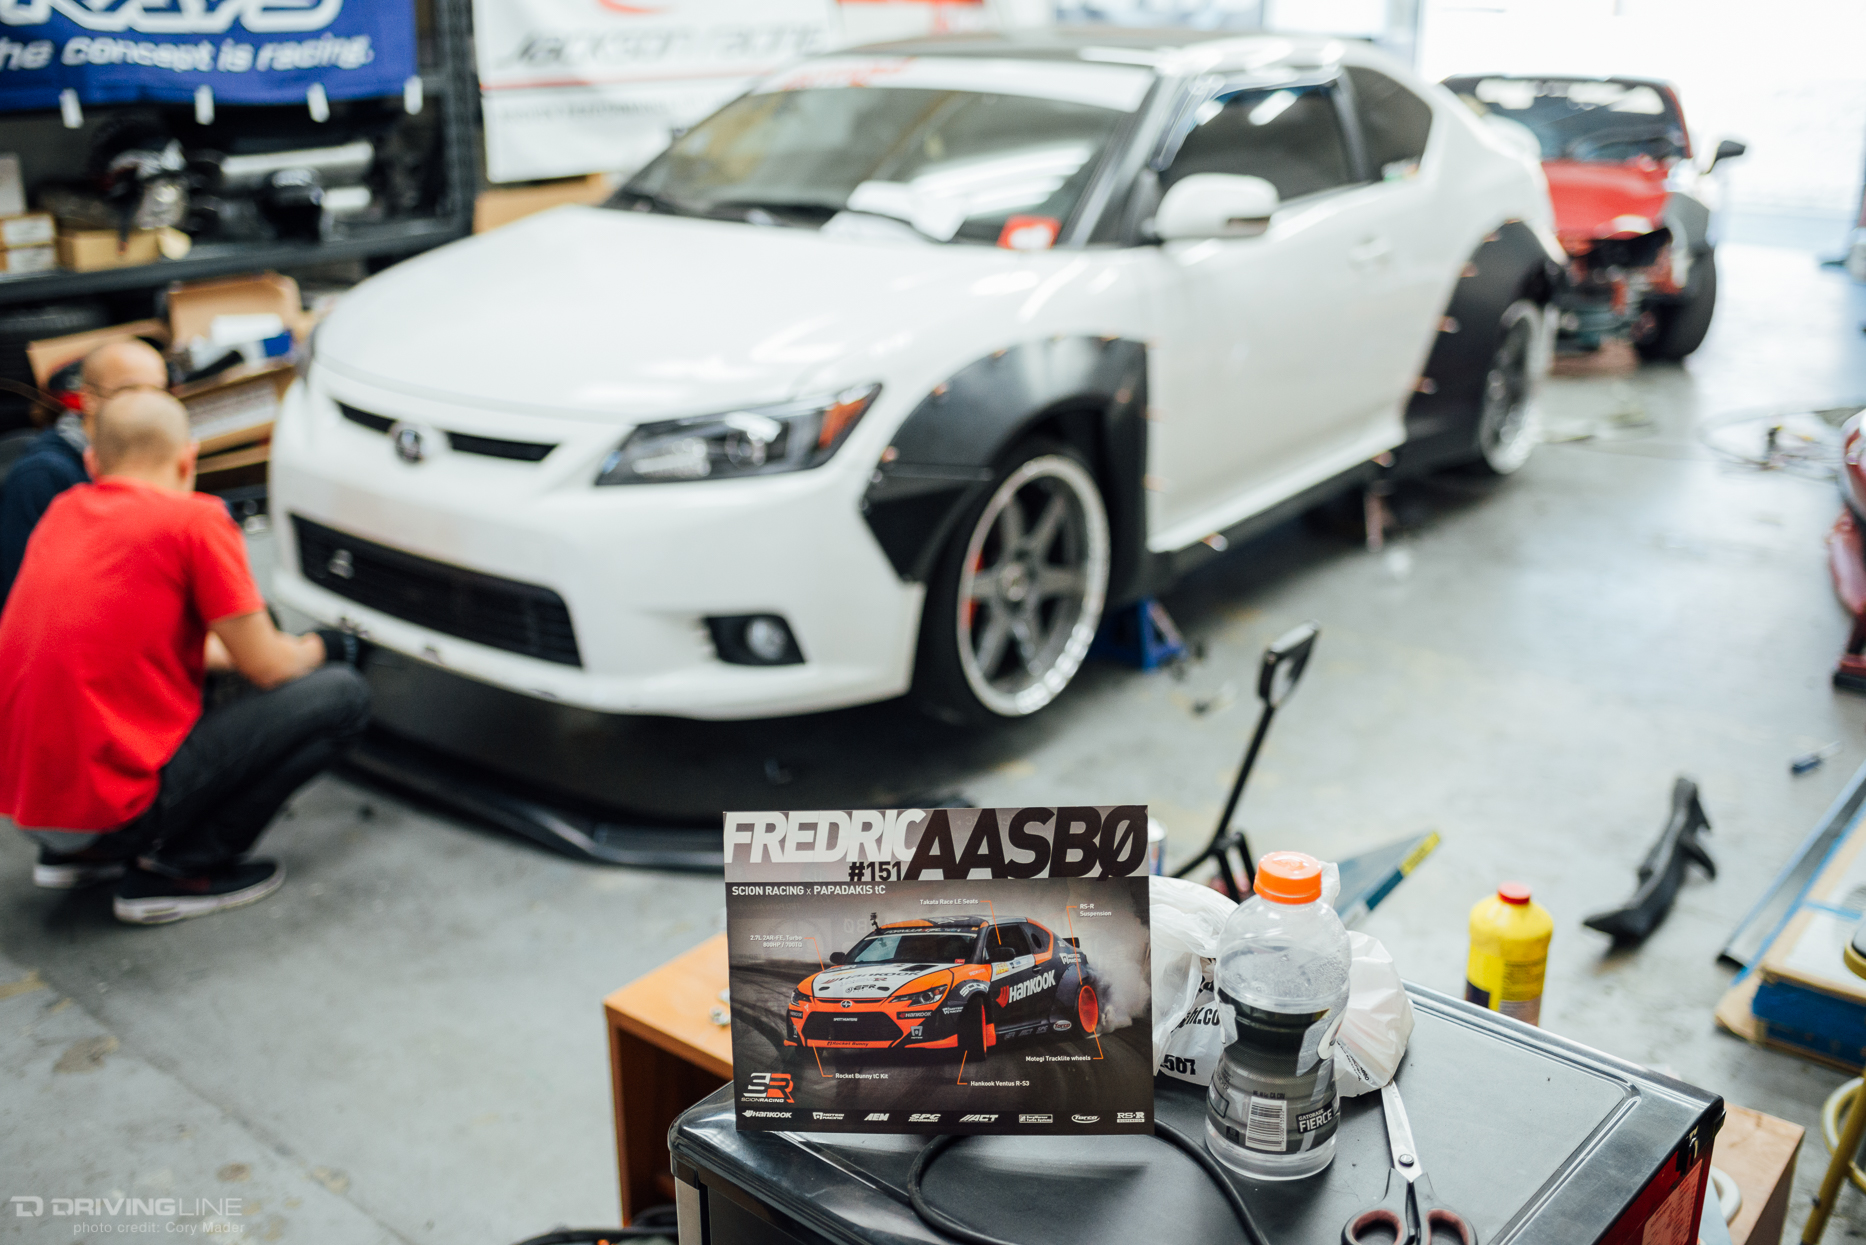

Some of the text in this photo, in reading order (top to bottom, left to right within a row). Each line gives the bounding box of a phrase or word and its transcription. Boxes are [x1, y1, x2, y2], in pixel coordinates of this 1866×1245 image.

[0, 36, 54, 71] he
[61, 36, 216, 73] concept
[217, 37, 254, 72] is
[724, 808, 926, 863] FREDRIC
[848, 861, 901, 882] #151
[732, 886, 763, 896] SCION
[765, 886, 804, 895] RACING
[814, 885, 873, 895] PAPADAKIS
[874, 885, 886, 894] tC
[1080, 910, 1112, 918] Suspension
[864, 1113, 889, 1121] AEM
[1299, 1108, 1333, 1133] FIERCE
